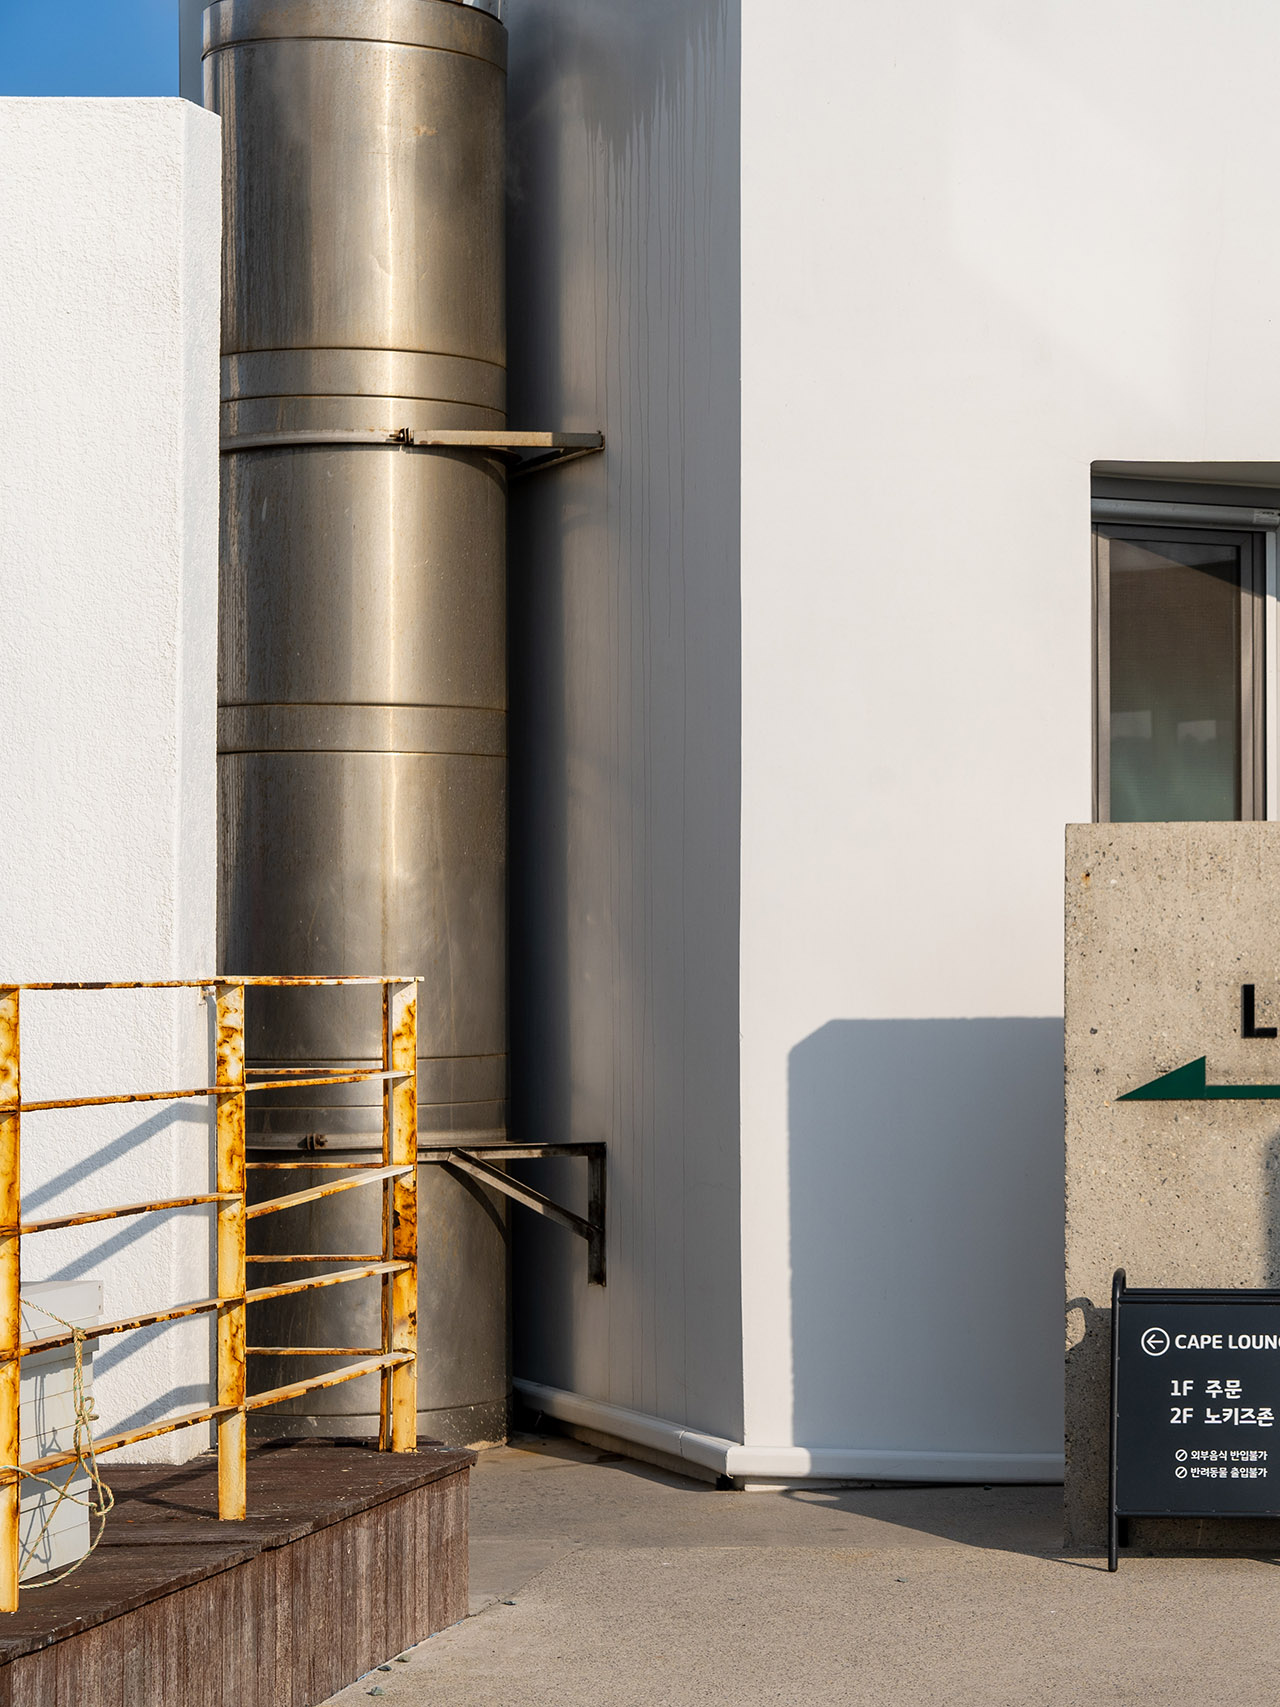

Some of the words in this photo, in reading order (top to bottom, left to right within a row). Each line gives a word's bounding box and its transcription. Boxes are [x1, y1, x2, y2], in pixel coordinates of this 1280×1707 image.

[1175, 1335, 1222, 1349] CAPE
[1171, 1380, 1193, 1396] 1F
[1205, 1380, 1242, 1399] 주문
[1170, 1408, 1193, 1423] 2F
[1204, 1408, 1274, 1426] 노키즈존
[1191, 1450, 1227, 1461] 외부음식
[1230, 1451, 1267, 1461] 반입불가
[1191, 1467, 1228, 1478] 반려동물
[1230, 1467, 1267, 1478] 출입불가
